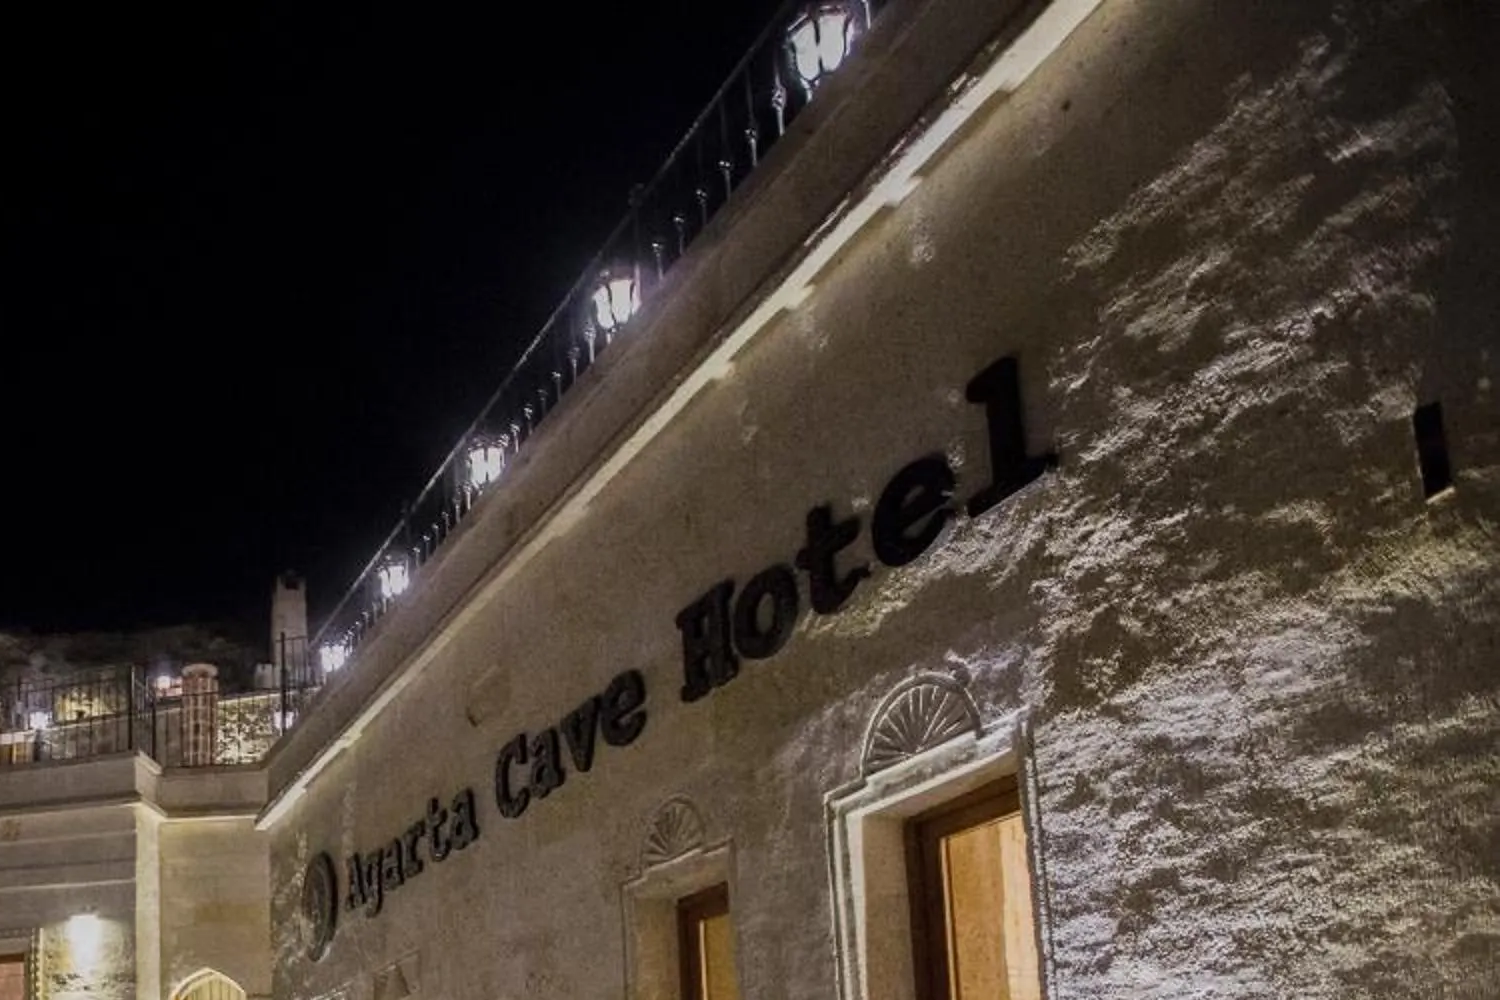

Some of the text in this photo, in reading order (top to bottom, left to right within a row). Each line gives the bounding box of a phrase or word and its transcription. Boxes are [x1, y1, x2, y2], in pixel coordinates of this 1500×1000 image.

[345, 355, 1059, 918] Agarta Cave Hotel
